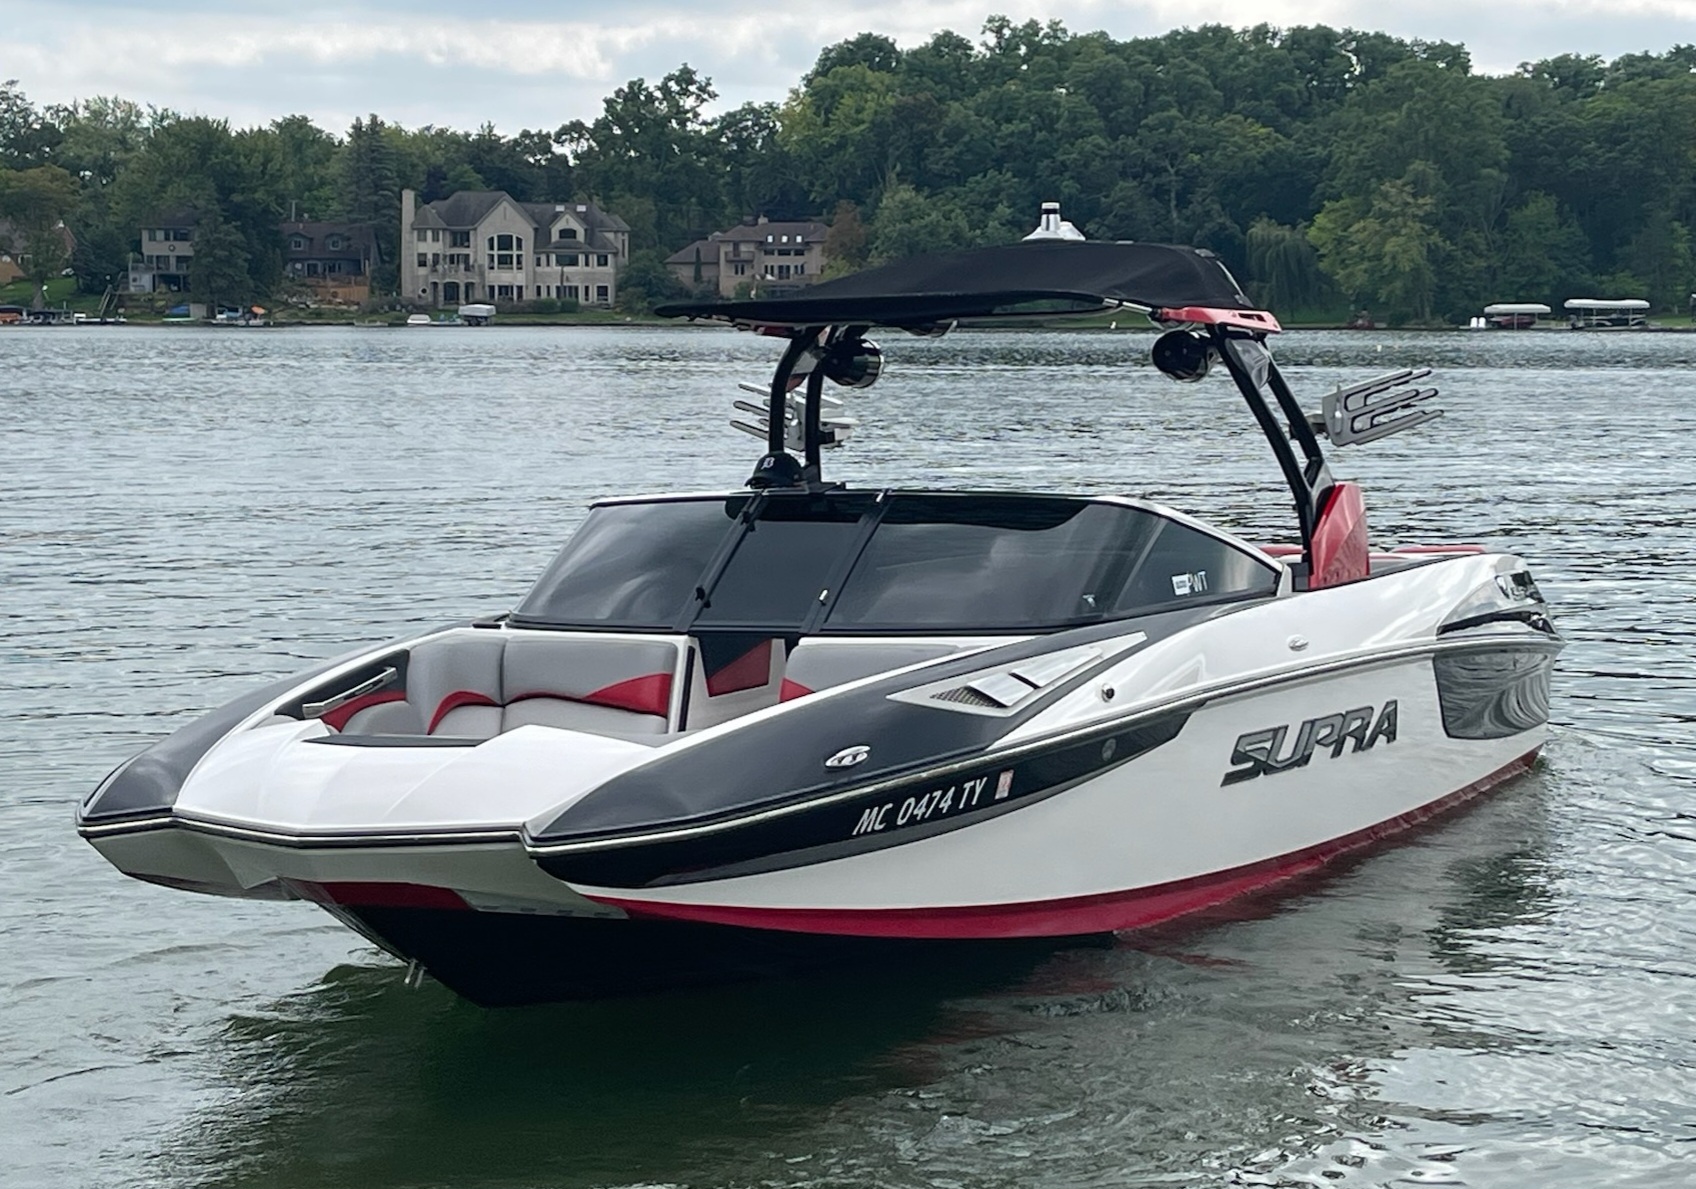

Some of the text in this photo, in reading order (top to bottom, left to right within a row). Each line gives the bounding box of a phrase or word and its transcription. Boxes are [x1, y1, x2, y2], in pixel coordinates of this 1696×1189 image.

[1220, 700, 1398, 787] SUPRA
[852, 803, 893, 835] MC
[897, 787, 956, 825] 0474
[958, 776, 988, 810] TY
